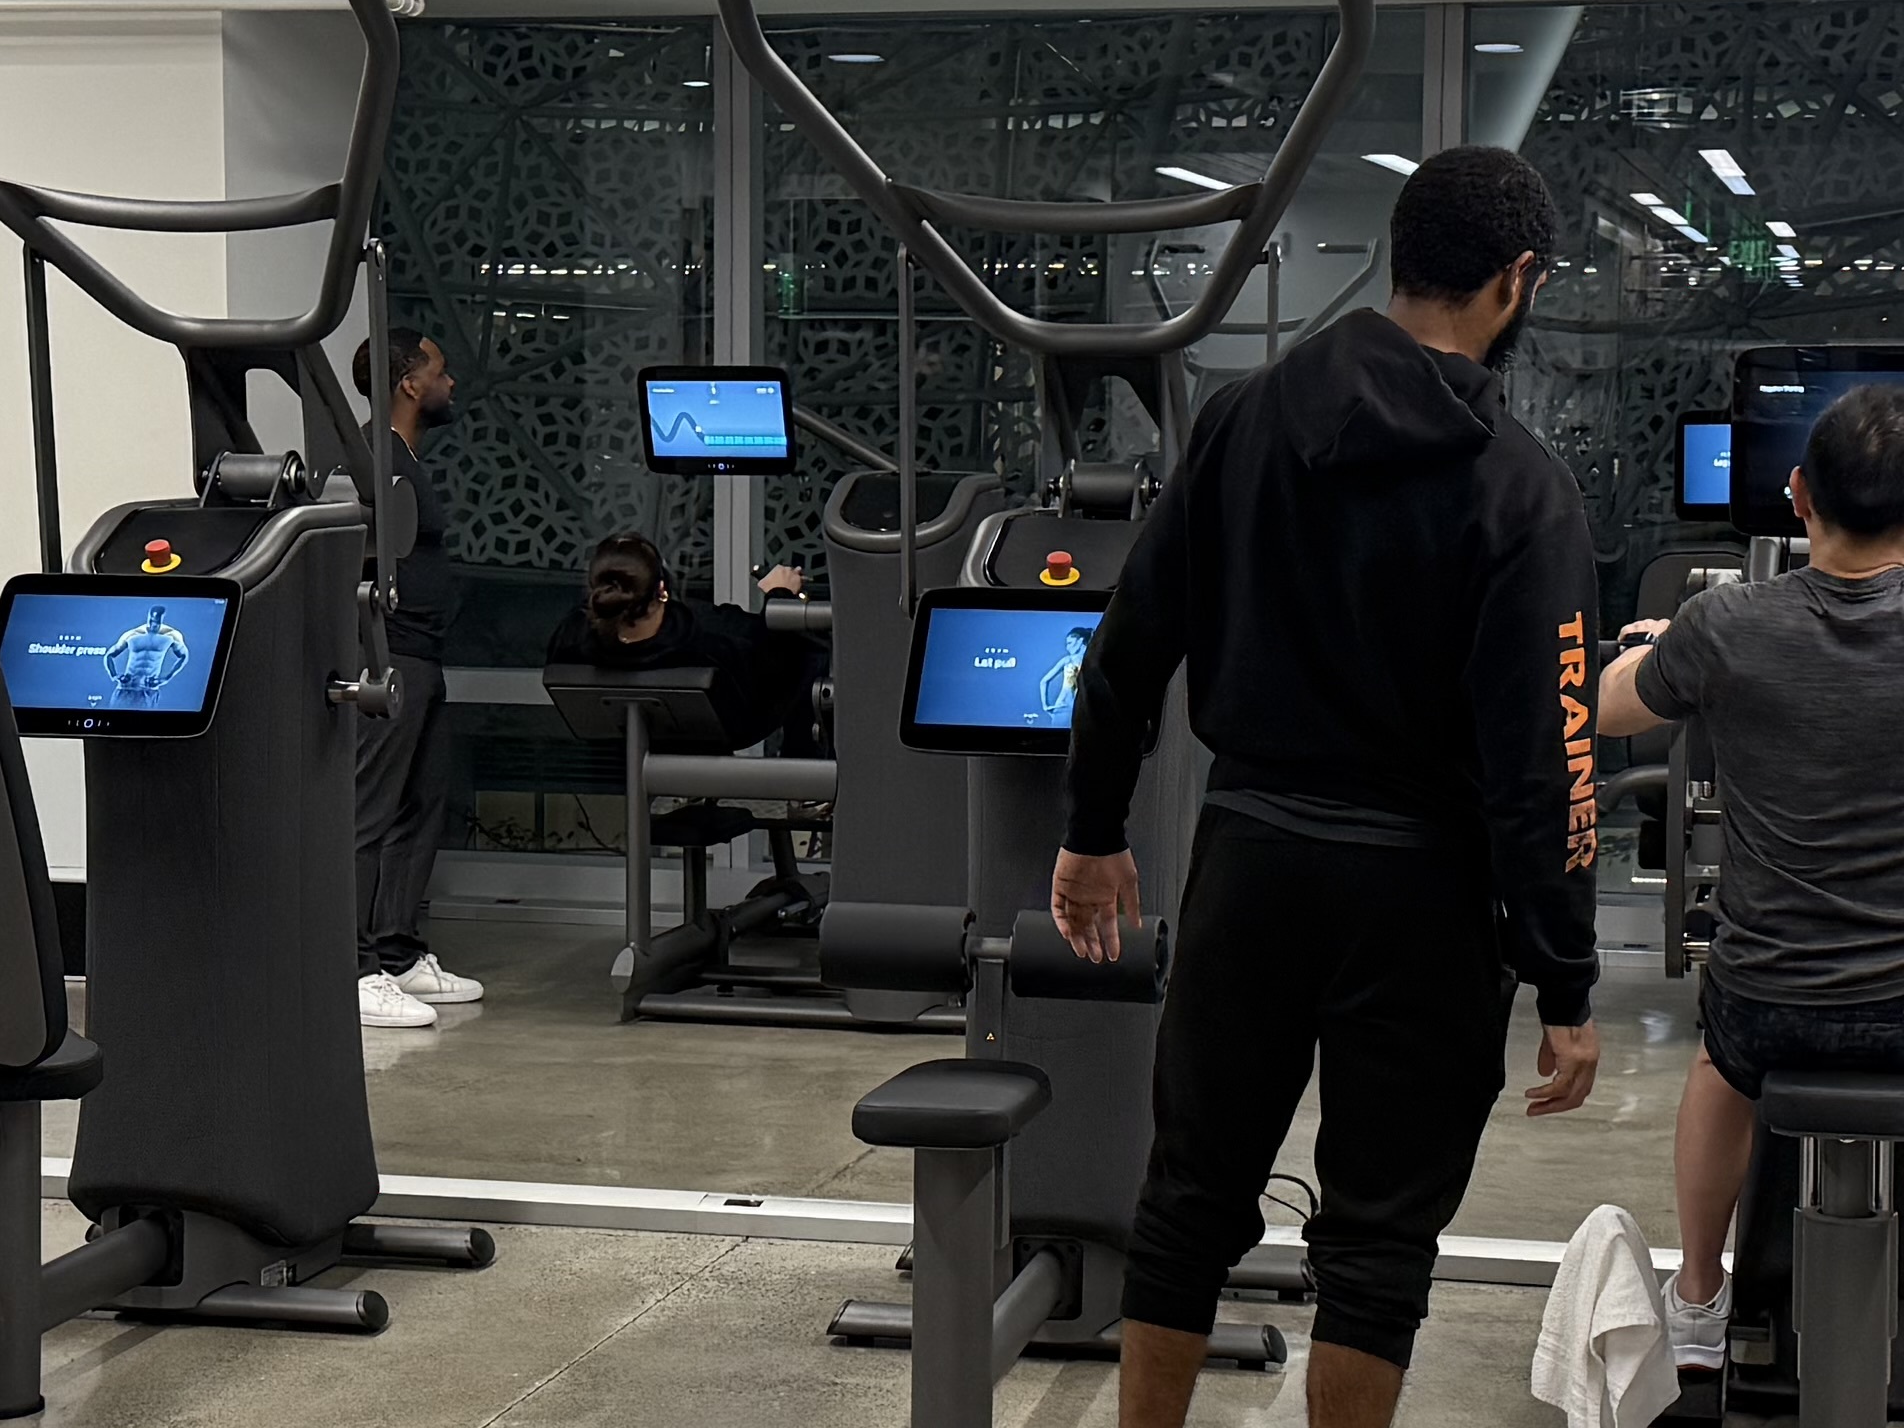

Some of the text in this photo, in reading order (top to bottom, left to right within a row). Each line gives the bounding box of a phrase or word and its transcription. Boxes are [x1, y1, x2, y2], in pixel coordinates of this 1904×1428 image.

[28, 643, 107, 657] Shoulder press
[974, 656, 993, 668] Lat
[1558, 611, 1597, 873] TRAINER
